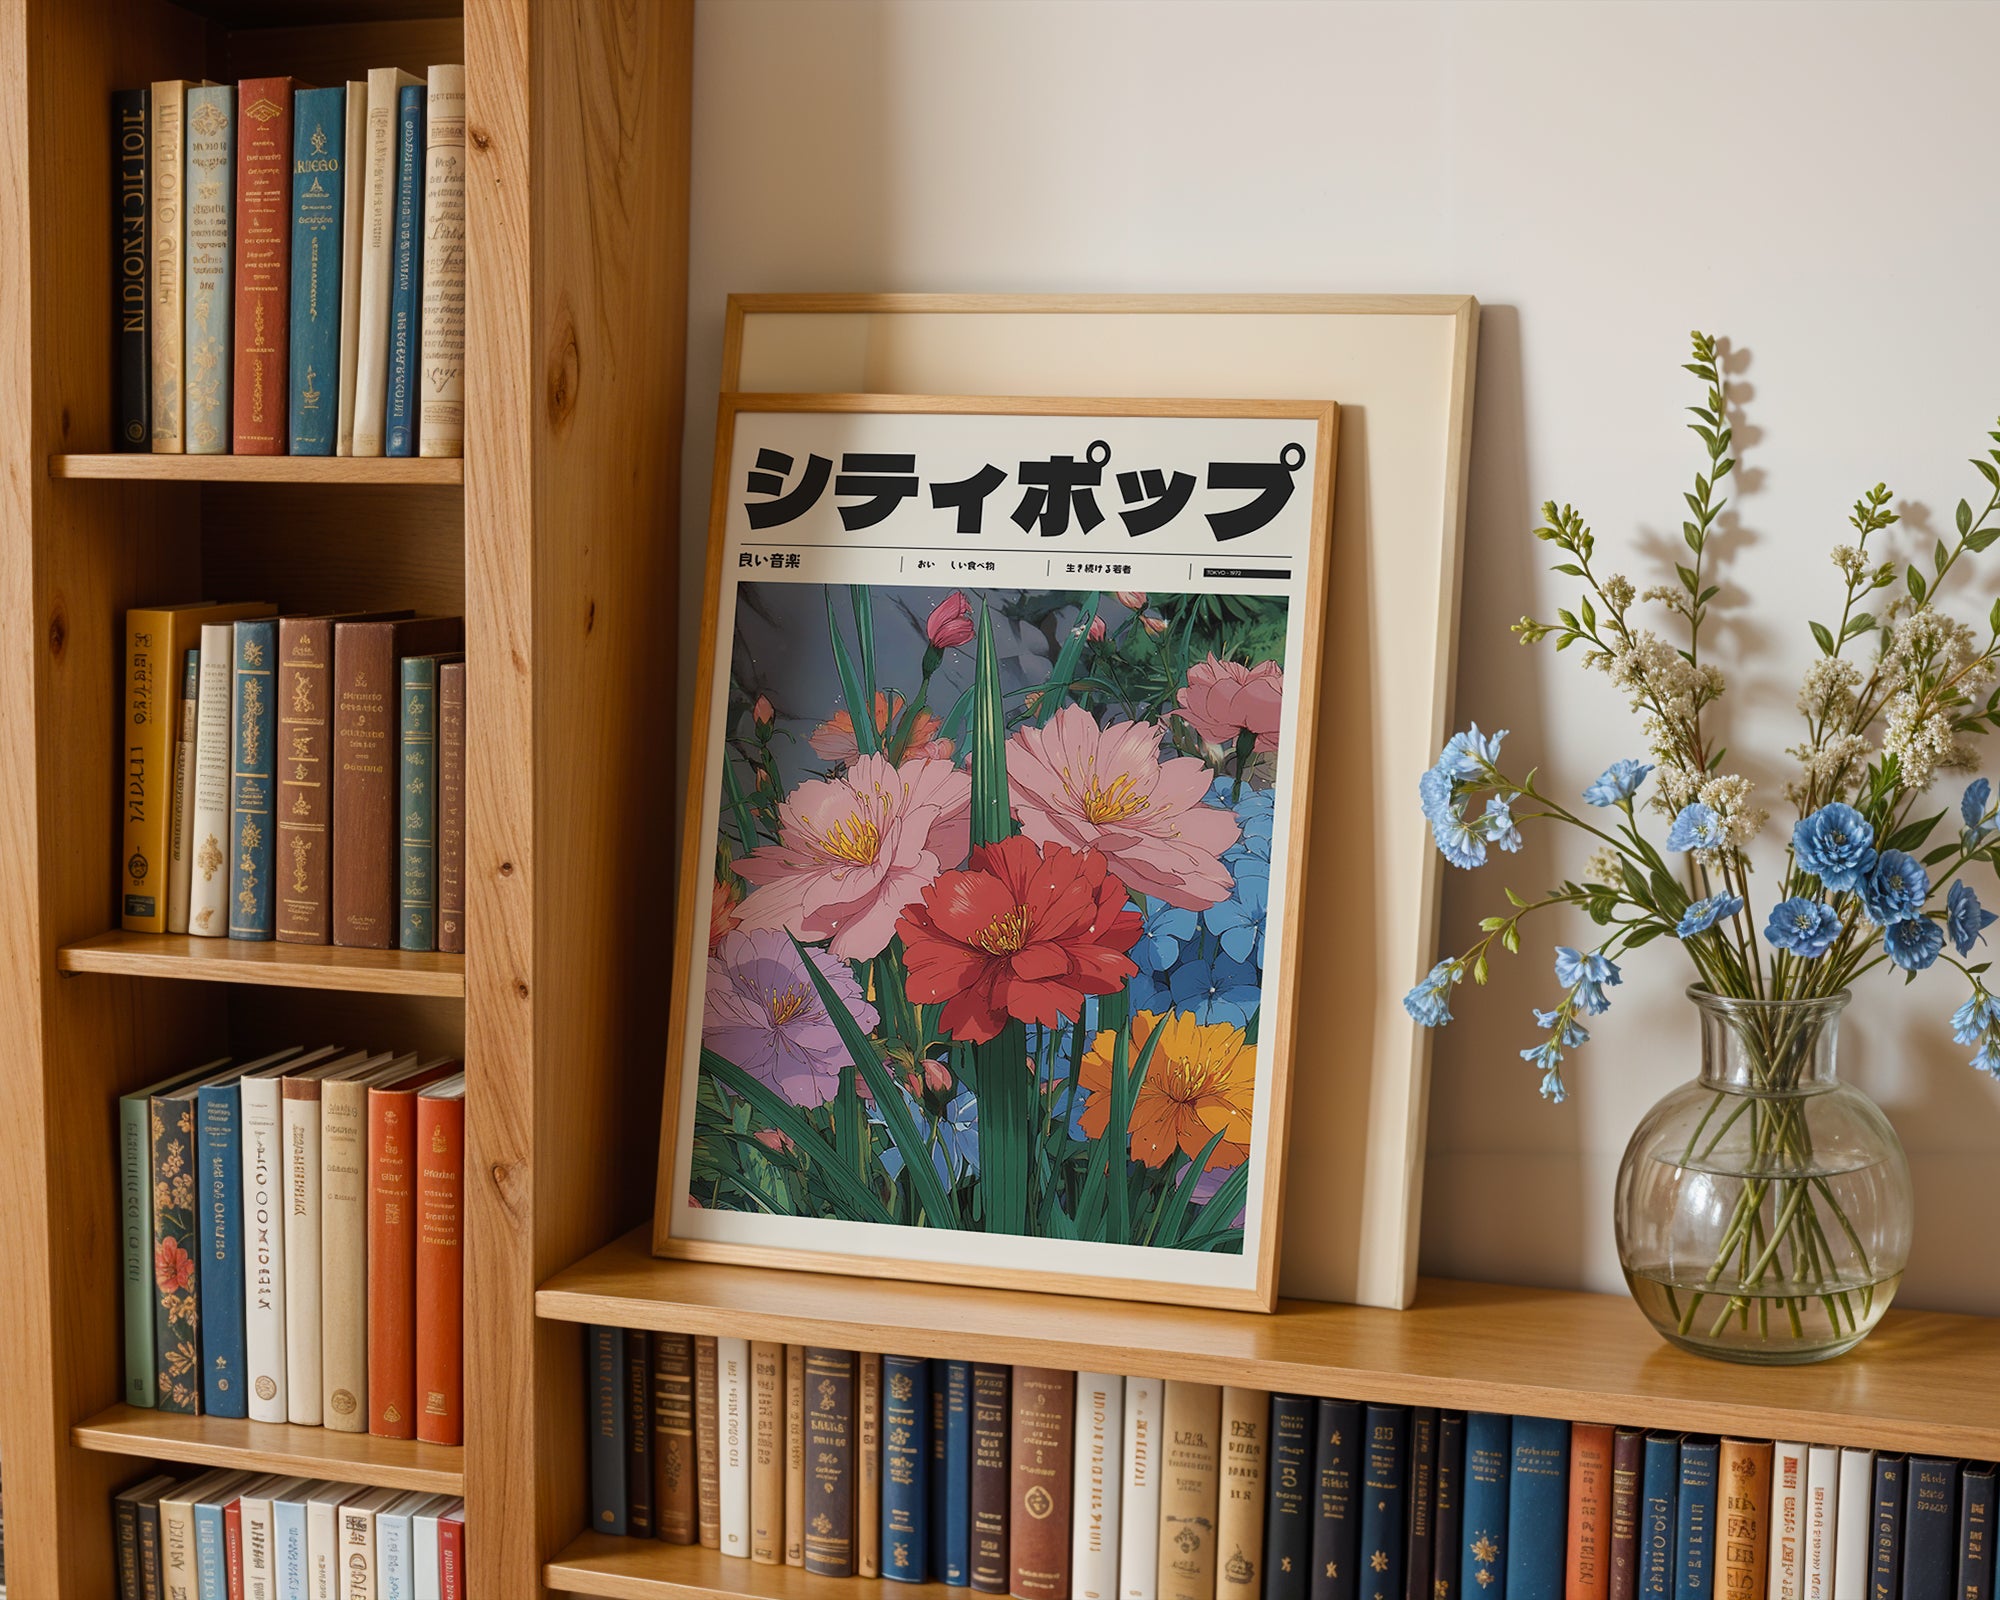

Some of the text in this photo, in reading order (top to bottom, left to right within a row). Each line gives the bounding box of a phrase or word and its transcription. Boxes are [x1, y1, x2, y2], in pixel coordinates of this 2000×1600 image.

[744, 440, 1305, 541] シティポップ
[738, 552, 800, 568] 良い音楽
[1066, 564, 1131, 574] 生き続ける若者
